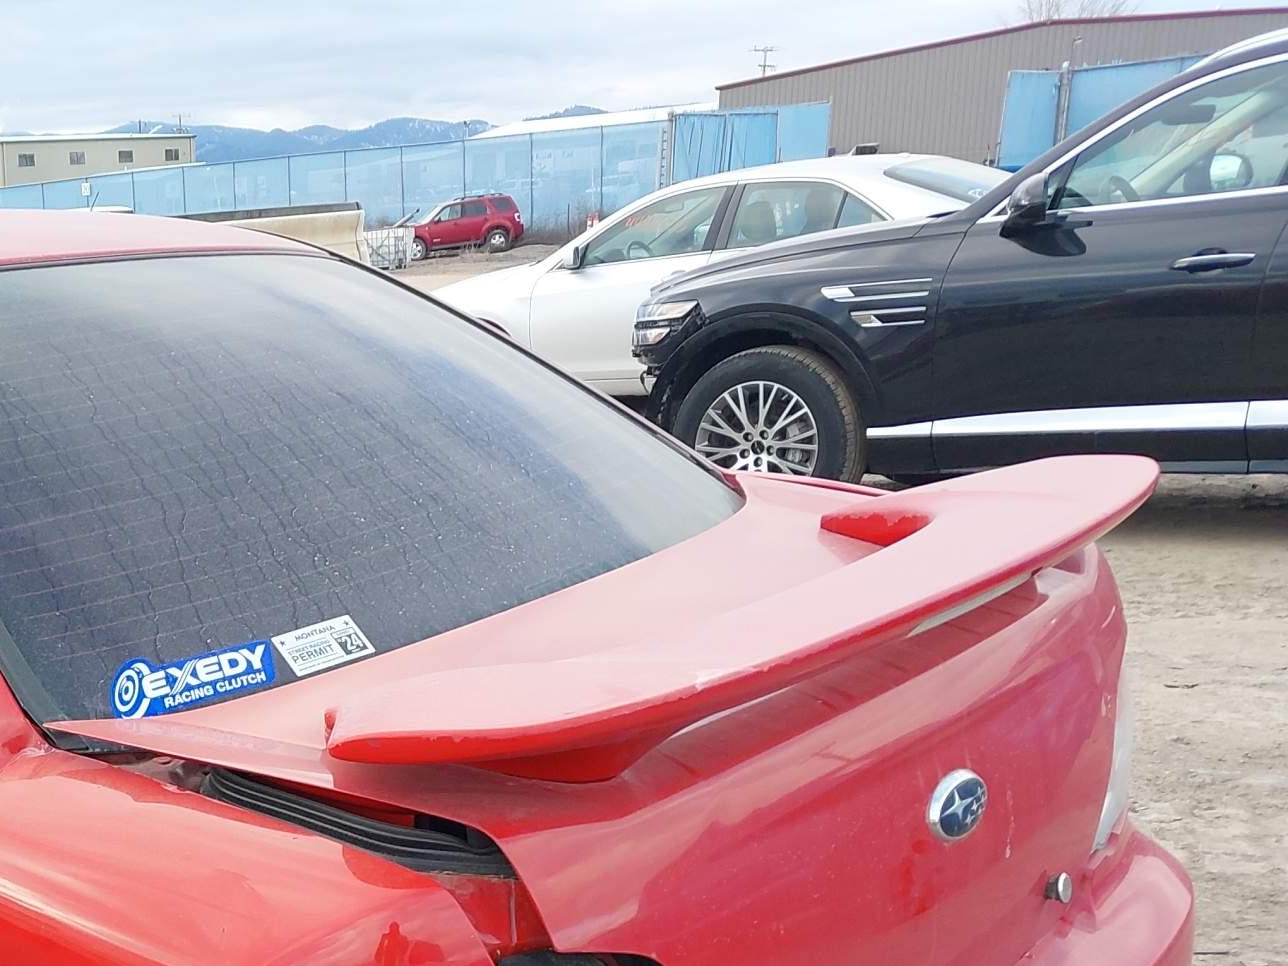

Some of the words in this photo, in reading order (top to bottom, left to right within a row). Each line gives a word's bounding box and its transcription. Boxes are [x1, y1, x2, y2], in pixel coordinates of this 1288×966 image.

[294, 625, 336, 641] MONTANA
[292, 644, 334, 663] PERMIT
[142, 644, 266, 697] EXEDY
[164, 685, 214, 709] RACING
[216, 671, 266, 694] CLUTCH
